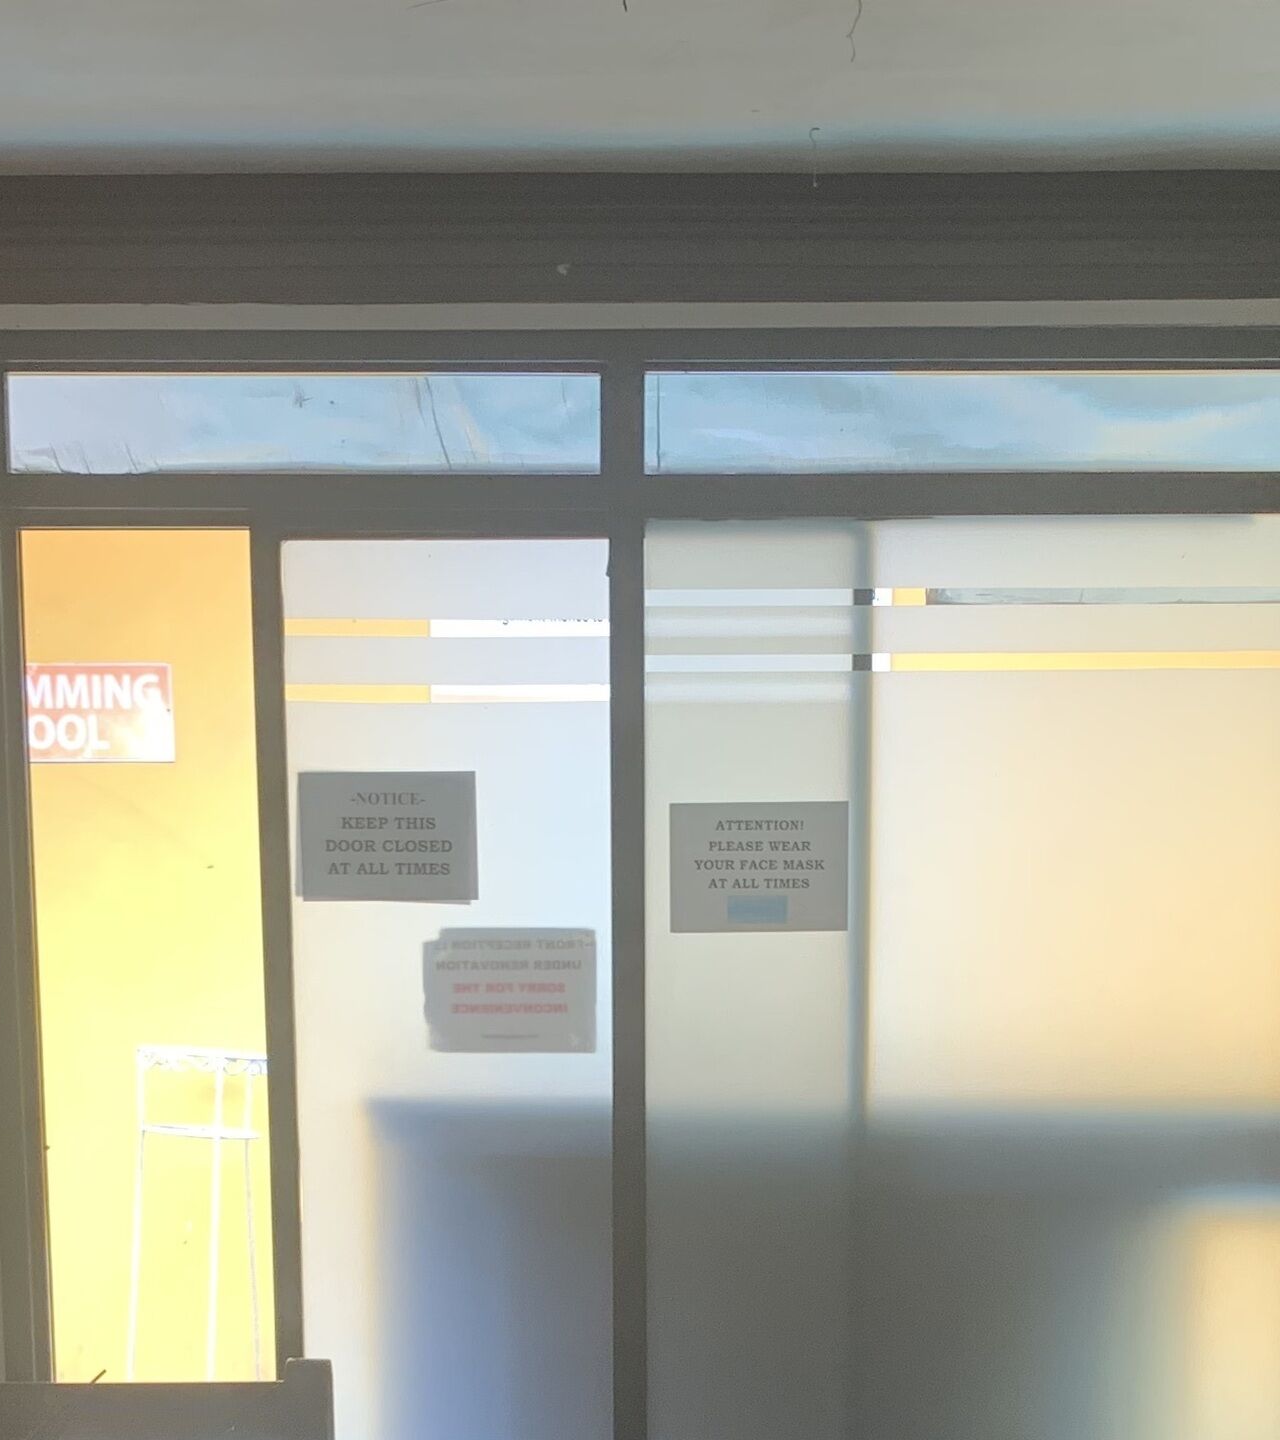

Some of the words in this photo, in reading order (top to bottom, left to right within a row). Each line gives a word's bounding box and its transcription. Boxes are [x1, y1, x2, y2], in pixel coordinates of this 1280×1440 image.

[341, 817, 389, 830] KEEP
[394, 817, 437, 830] THIS
[715, 819, 805, 832] ATTENTION!
[325, 839, 377, 852] DOOR
[382, 839, 453, 853] CLOSED
[708, 840, 764, 852] PLEASE
[768, 840, 812, 852] WEAR
[328, 862, 351, 875] AT
[356, 862, 390, 875] ALL
[395, 862, 451, 876] TIMES
[694, 859, 735, 871] YOUR
[740, 859, 778, 871] FACE
[783, 859, 825, 871] MASK
[707, 878, 728, 889] AT
[732, 878, 760, 889] ALL
[764, 878, 810, 889] TIMES
